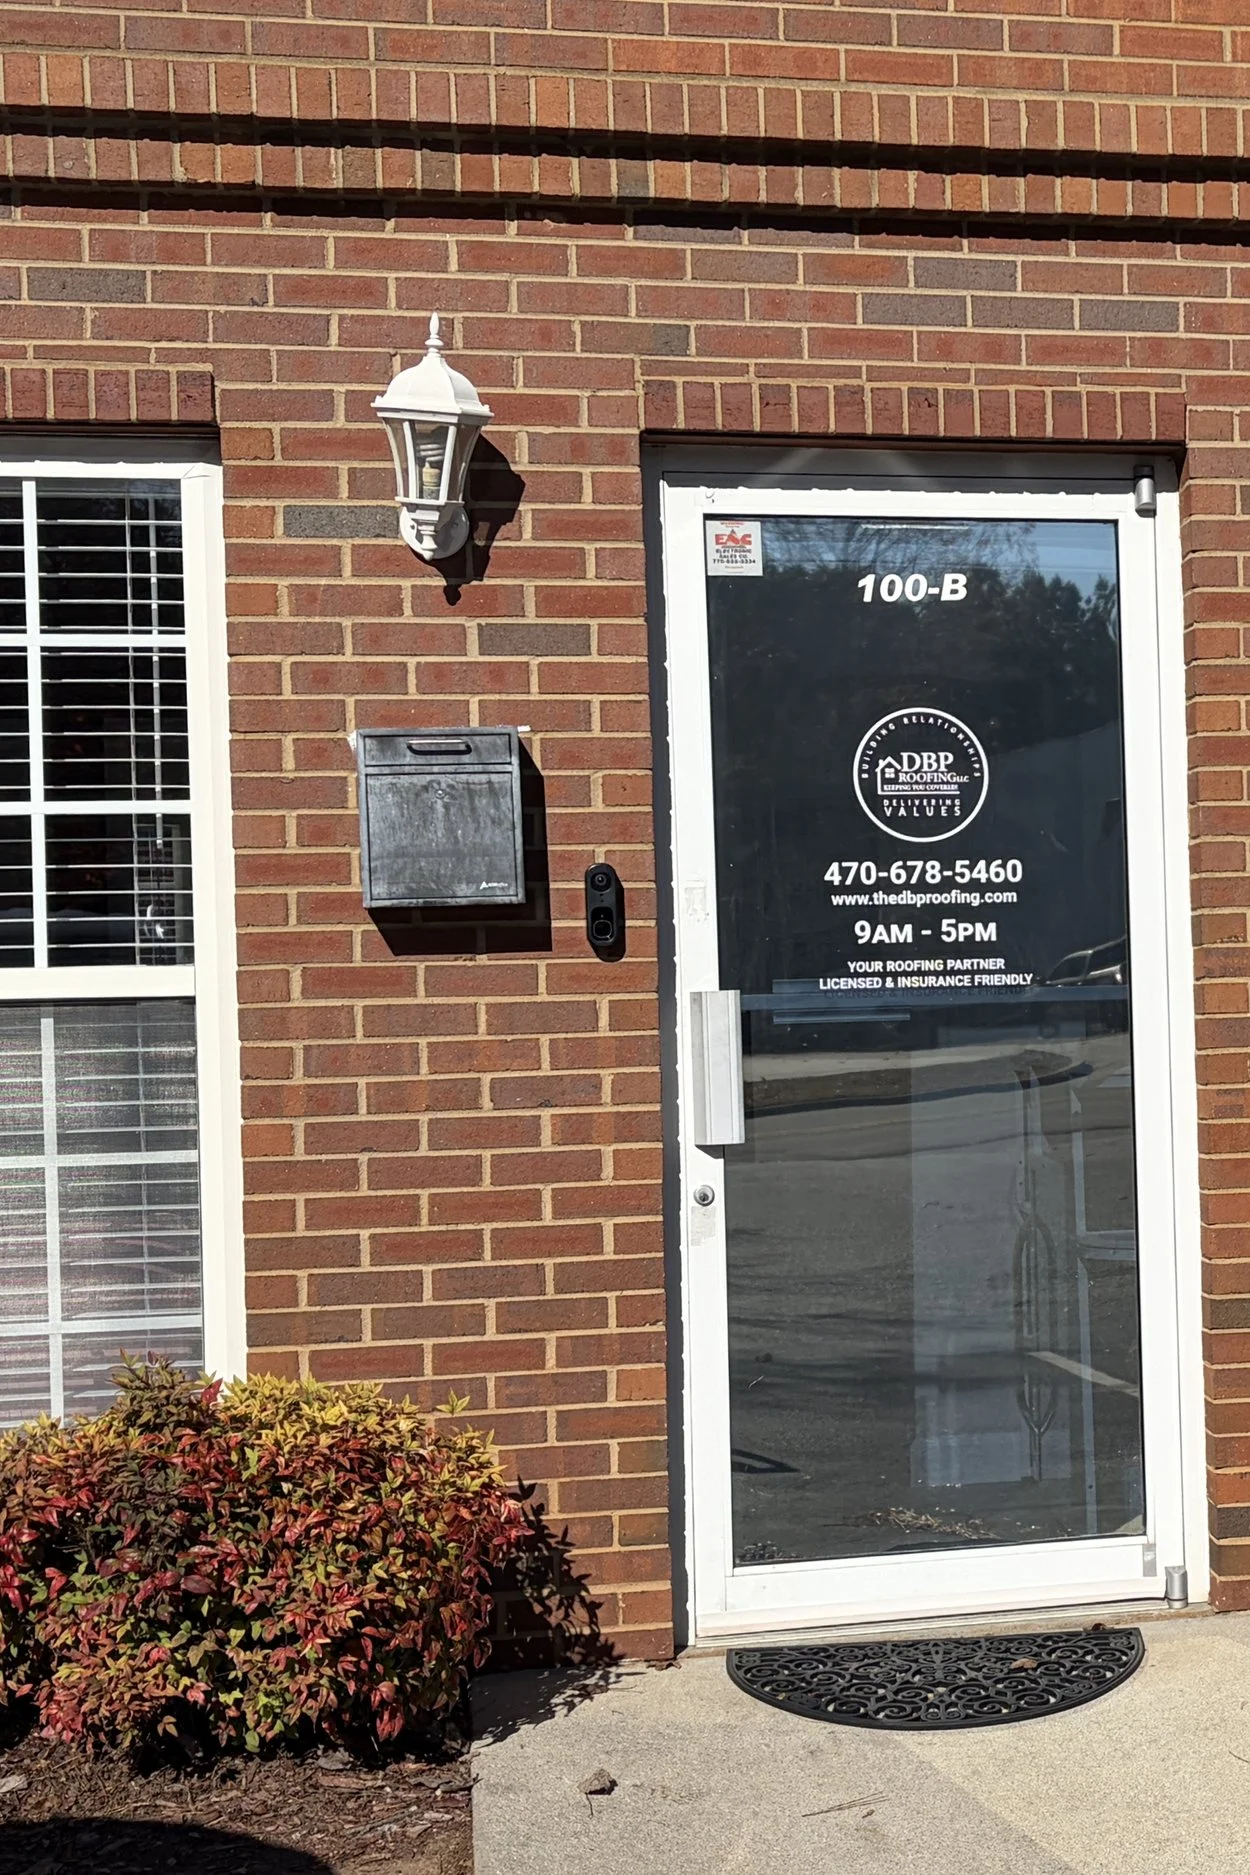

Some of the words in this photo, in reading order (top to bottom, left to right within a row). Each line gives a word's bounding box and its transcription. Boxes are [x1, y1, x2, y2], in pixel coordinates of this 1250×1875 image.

[857, 573, 968, 602] 100-B
[861, 723, 896, 779] BUILDING
[903, 715, 981, 777] RELATIONSHIPS
[900, 751, 955, 772] DBP
[898, 772, 957, 783] ROOFING
[883, 806, 961, 817] VALUES
[824, 859, 1023, 886] 470-678-5460
[831, 890, 1018, 907] www.thedbproofing.com
[854, 920, 913, 944] 9AM
[940, 919, 998, 942] 5PM
[847, 961, 884, 973] YOUR
[886, 960, 944, 972] ROOFING
[946, 958, 1006, 970] PARTNER
[819, 977, 882, 990] LICENSED
[885, 977, 895, 988] &
[897, 975, 972, 988] INSURANCE
[974, 973, 1033, 986] FRIENDLY
